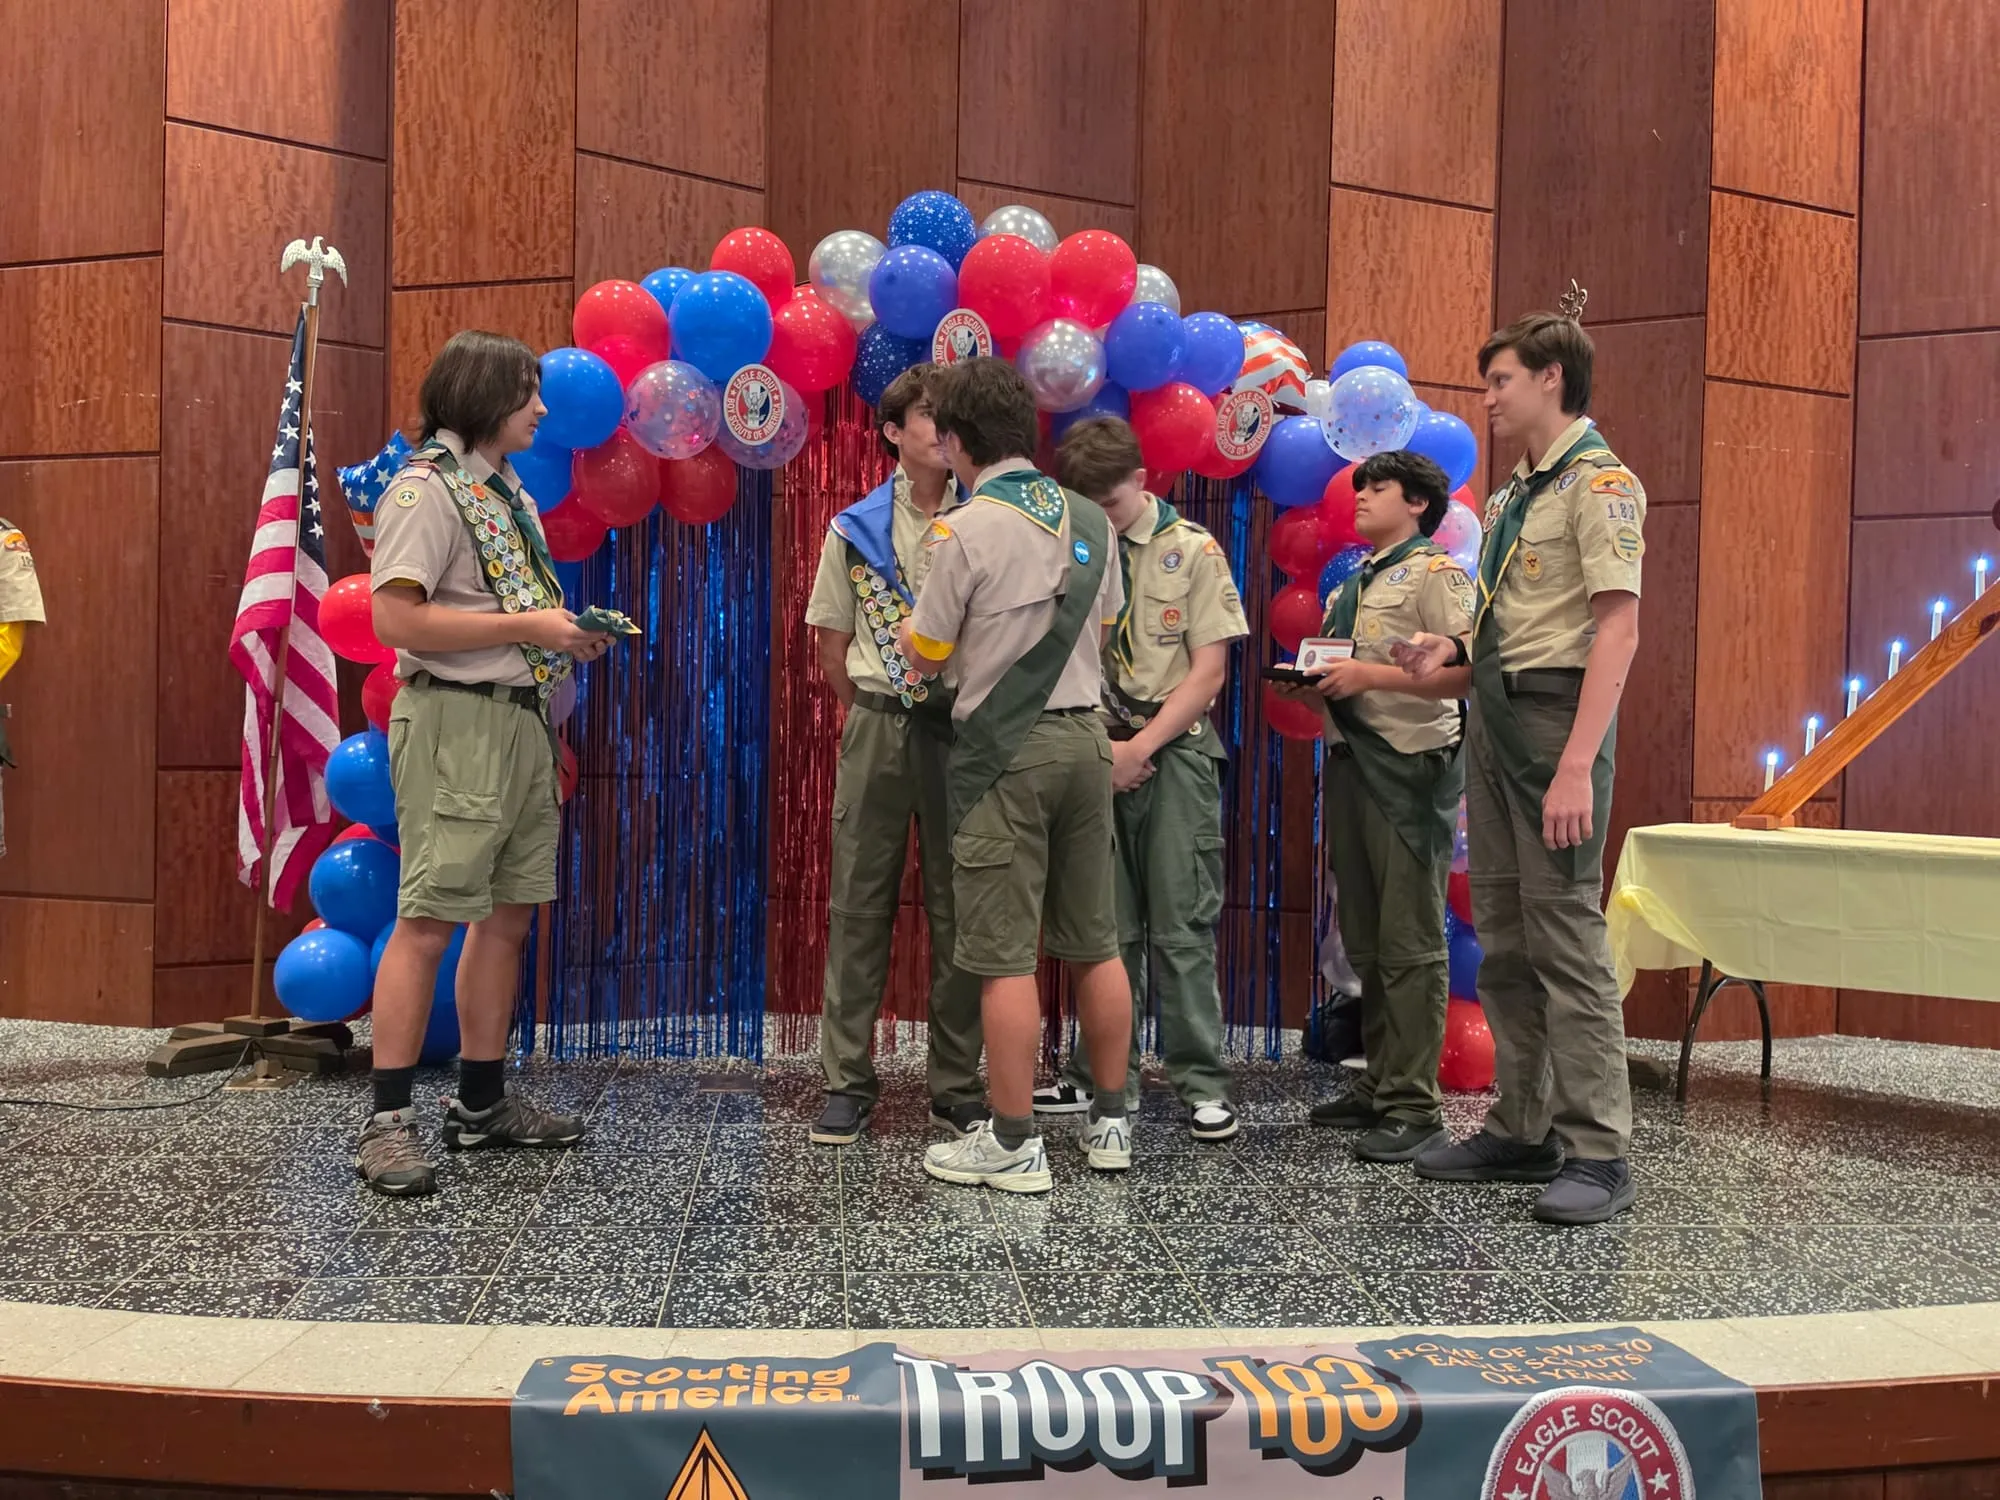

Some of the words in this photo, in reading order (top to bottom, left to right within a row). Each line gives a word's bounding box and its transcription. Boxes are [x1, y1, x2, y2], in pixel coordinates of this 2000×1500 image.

[941, 315, 963, 335] EAGLE
[963, 315, 986, 336] SCOUT
[733, 370, 757, 390] EAGLE
[757, 370, 778, 393] SCOUT
[729, 415, 753, 440] SCOUTS
[753, 430, 764, 440] OF
[1607, 502, 1635, 520] 183
[1386, 1343, 1483, 1361] HOME
[1488, 1346, 1526, 1360] OF
[1616, 1338, 1653, 1352] 70
[1524, 1352, 1653, 1369] SCOUTS!
[564, 1362, 851, 1386] Scouting
[1480, 1370, 1540, 1385] OH
[1540, 1368, 1637, 1382] YEAH!
[563, 1380, 843, 1415] America
[893, 1353, 1207, 1466] TROOP
[1215, 1356, 1399, 1455] 183
[1516, 1405, 1579, 1475] EAGLE
[1588, 1403, 1660, 1459] SCOUT
